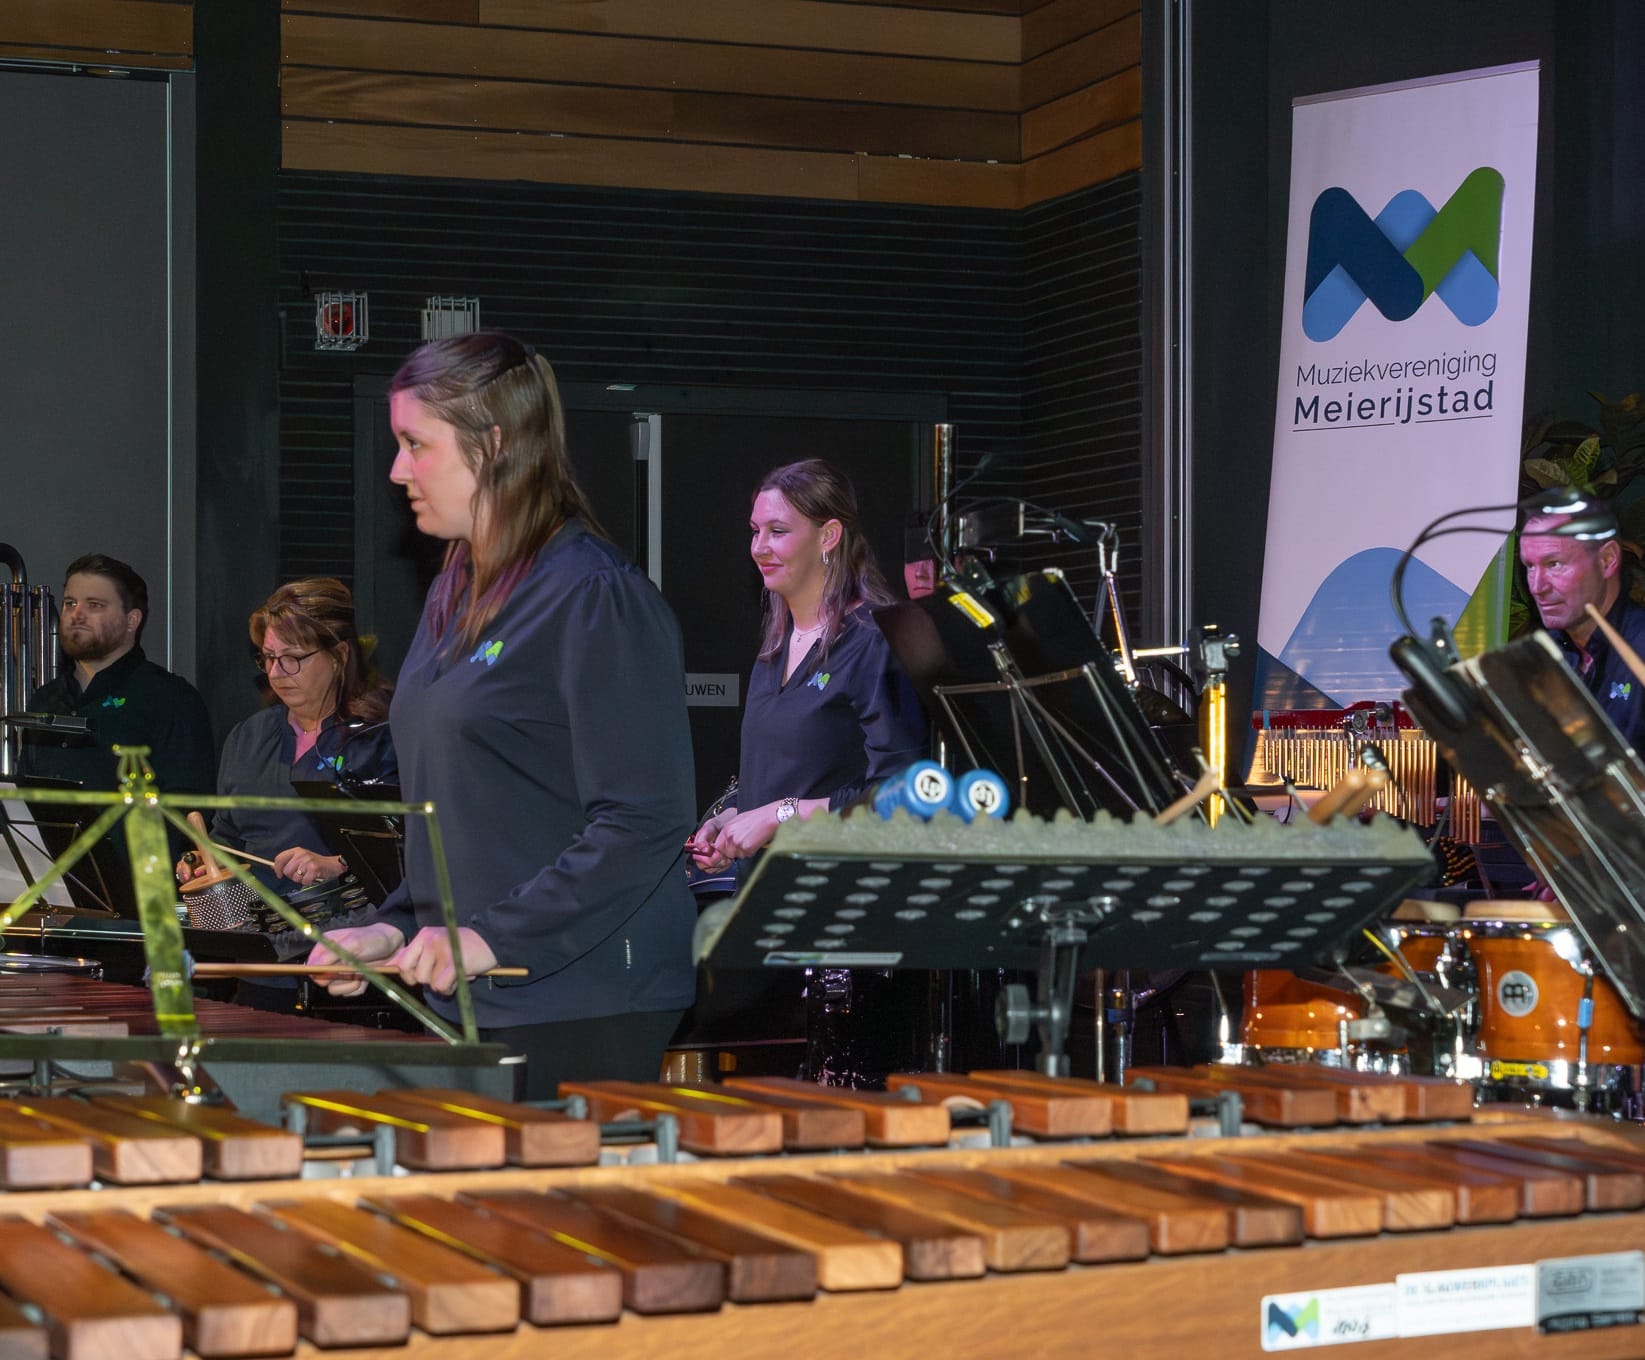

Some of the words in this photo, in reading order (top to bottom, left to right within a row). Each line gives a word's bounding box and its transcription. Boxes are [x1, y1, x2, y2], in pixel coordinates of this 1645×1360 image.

[1296, 350, 1497, 387] Muziekvereniging
[1294, 380, 1494, 425] Meierijstad
[685, 683, 726, 697] UWEN
